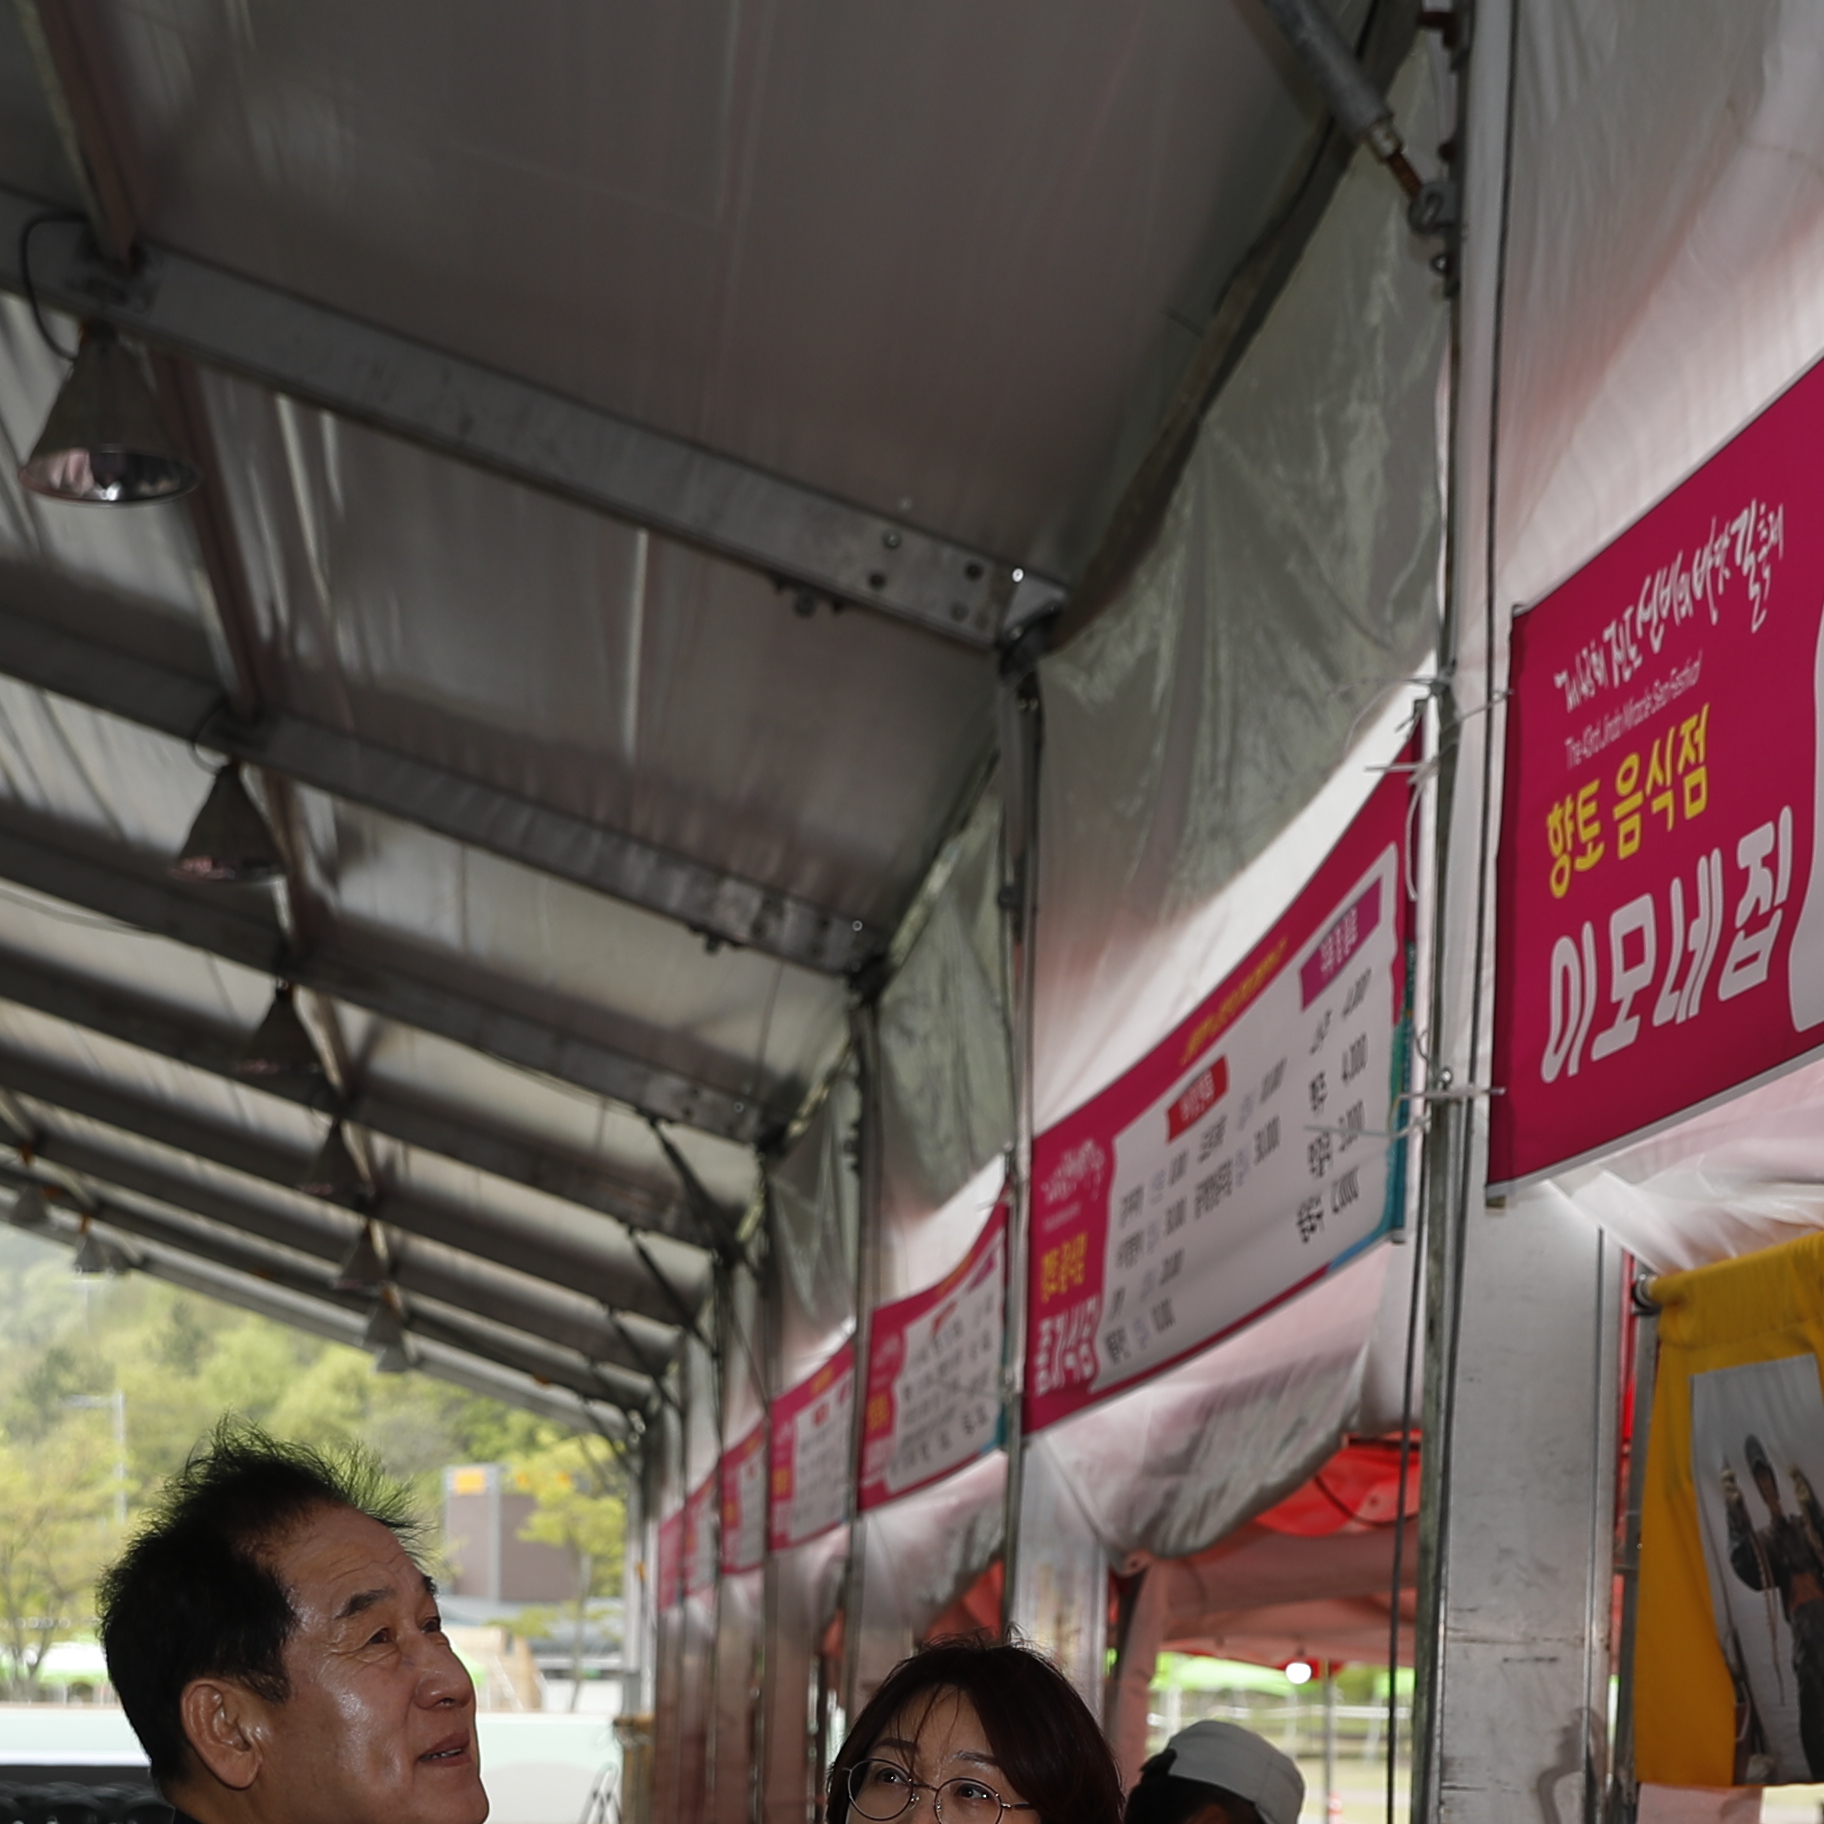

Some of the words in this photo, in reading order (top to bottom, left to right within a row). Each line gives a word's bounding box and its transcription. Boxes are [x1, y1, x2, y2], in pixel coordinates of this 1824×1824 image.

[1545, 778, 1605, 899] 향토
[1612, 701, 1711, 861] 음식점
[1540, 805, 1794, 1084] 이모네집
